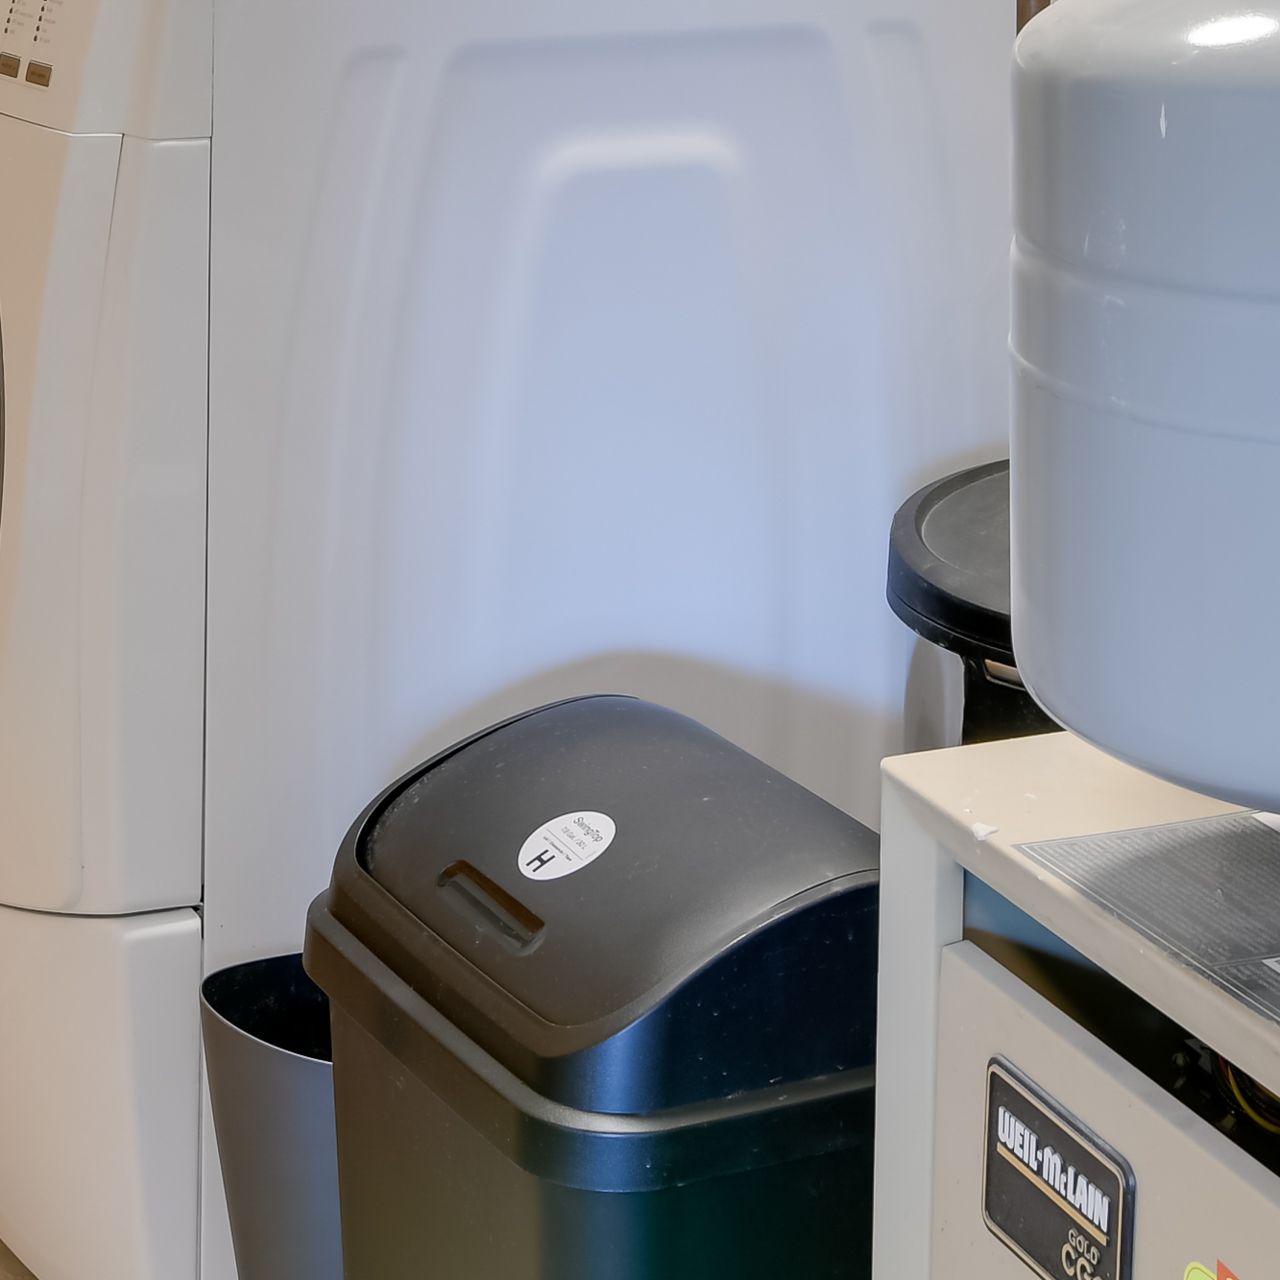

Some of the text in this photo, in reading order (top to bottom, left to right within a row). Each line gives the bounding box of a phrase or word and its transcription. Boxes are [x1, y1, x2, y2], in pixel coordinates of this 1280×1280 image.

[525, 849, 556, 873] H
[1061, 1242, 1105, 1280] CG
[1068, 1227, 1099, 1265] GOLD
